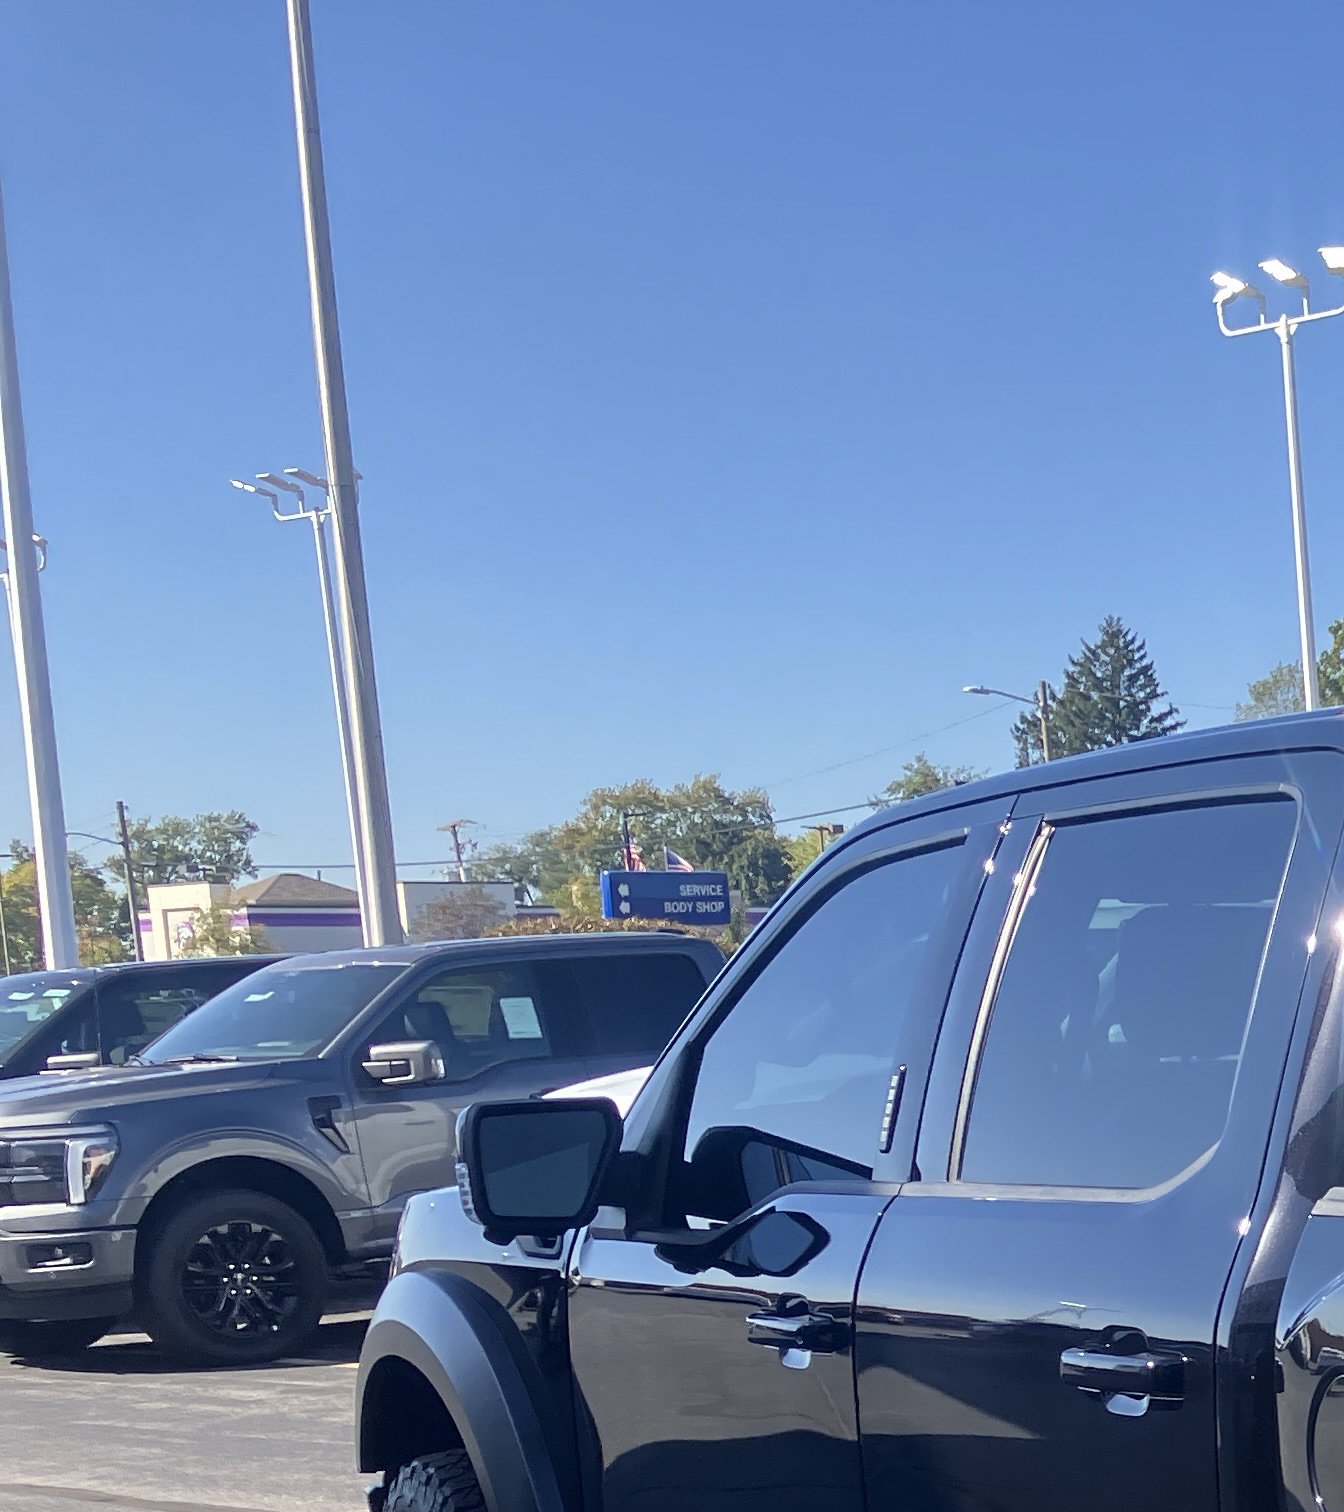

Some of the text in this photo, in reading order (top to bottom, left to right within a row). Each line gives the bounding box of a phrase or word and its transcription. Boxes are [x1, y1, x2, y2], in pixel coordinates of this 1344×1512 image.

[679, 884, 724, 896] SERVICE
[664, 901, 725, 913] BODY SHOP
